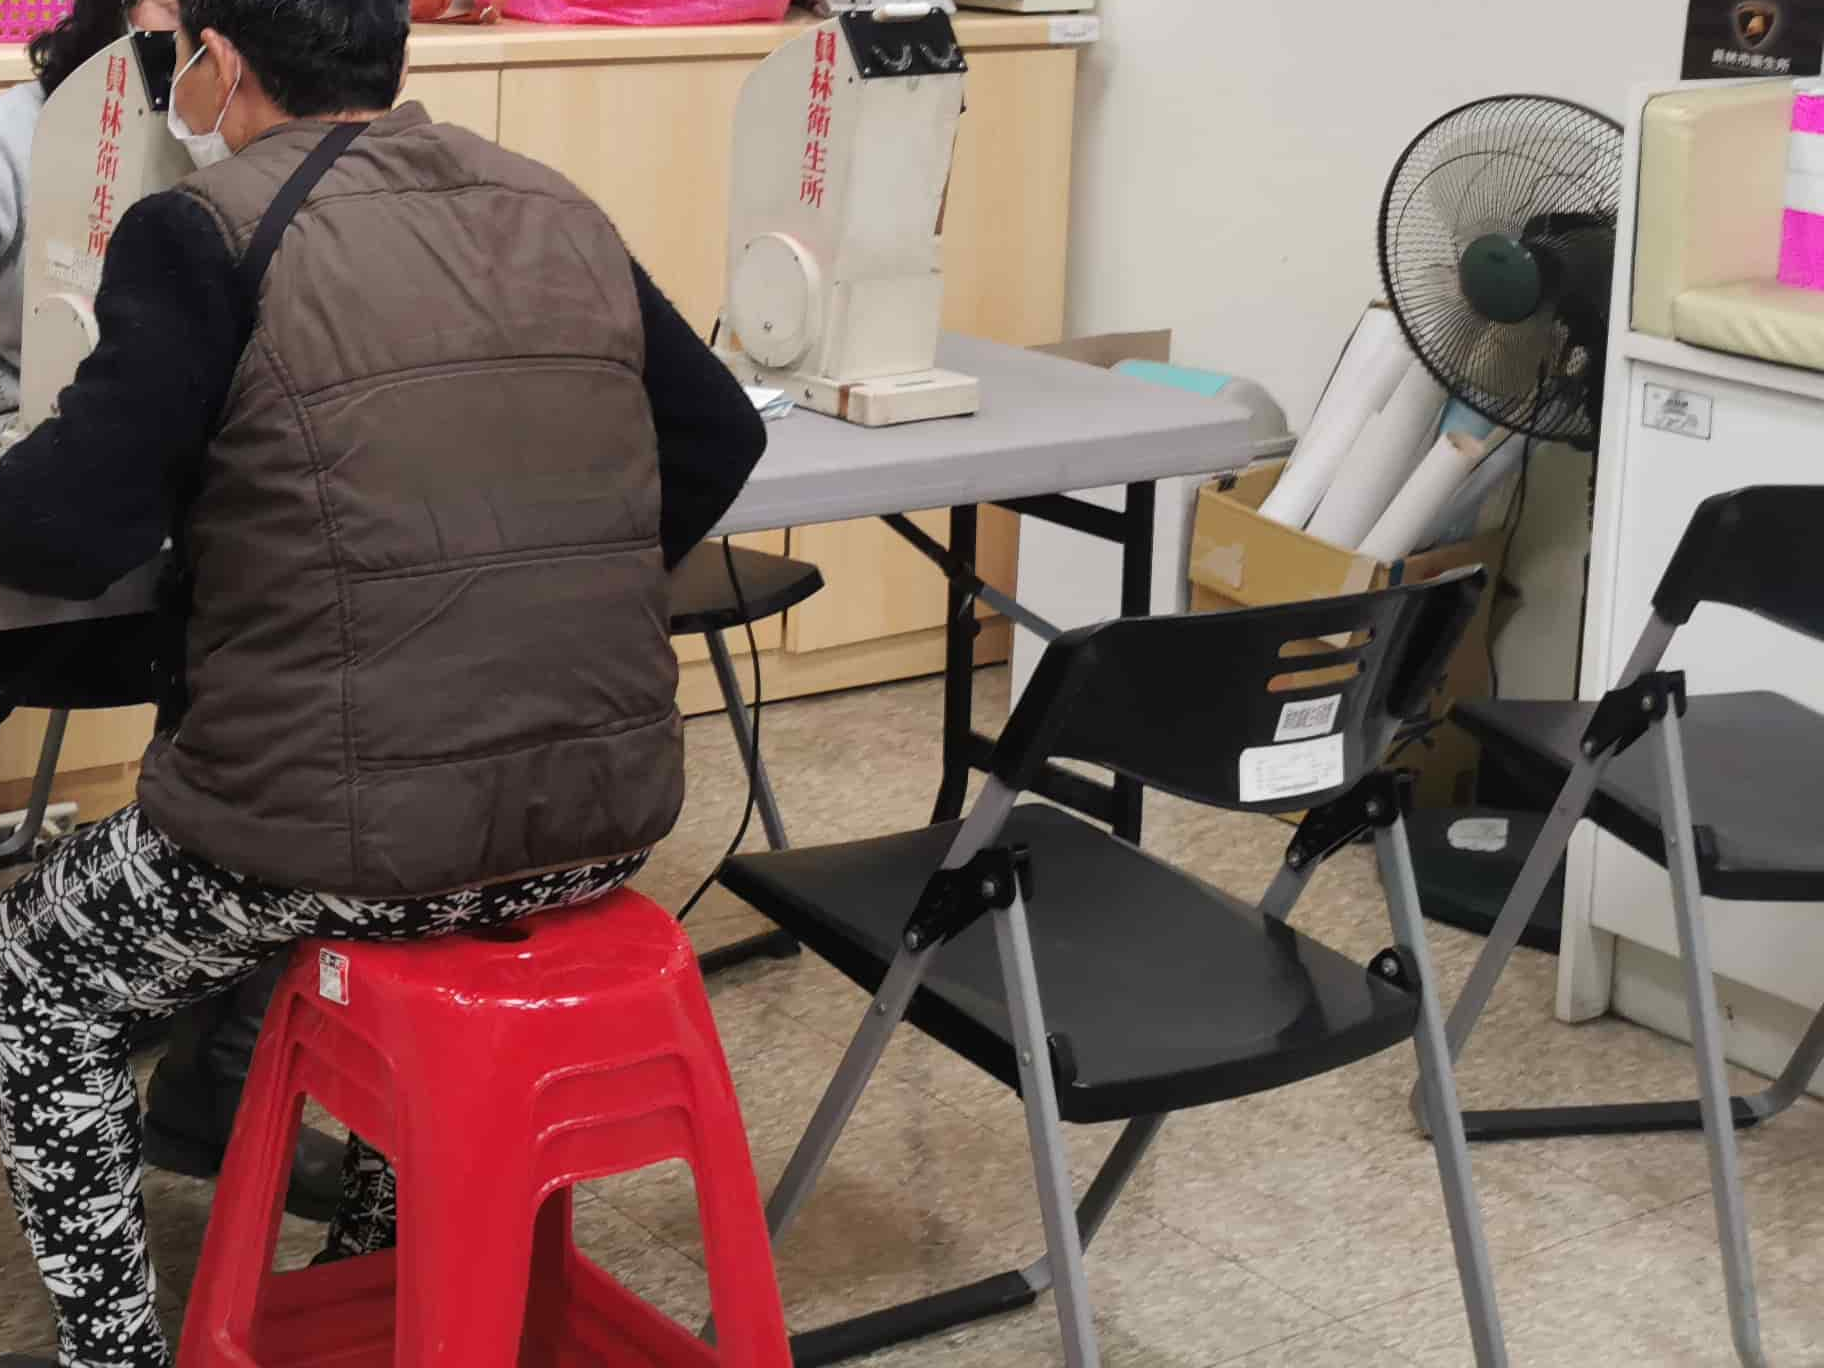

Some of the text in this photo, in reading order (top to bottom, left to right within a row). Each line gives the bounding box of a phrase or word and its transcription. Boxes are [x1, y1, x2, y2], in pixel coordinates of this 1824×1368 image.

[799, 30, 837, 208] 員林衛生所
